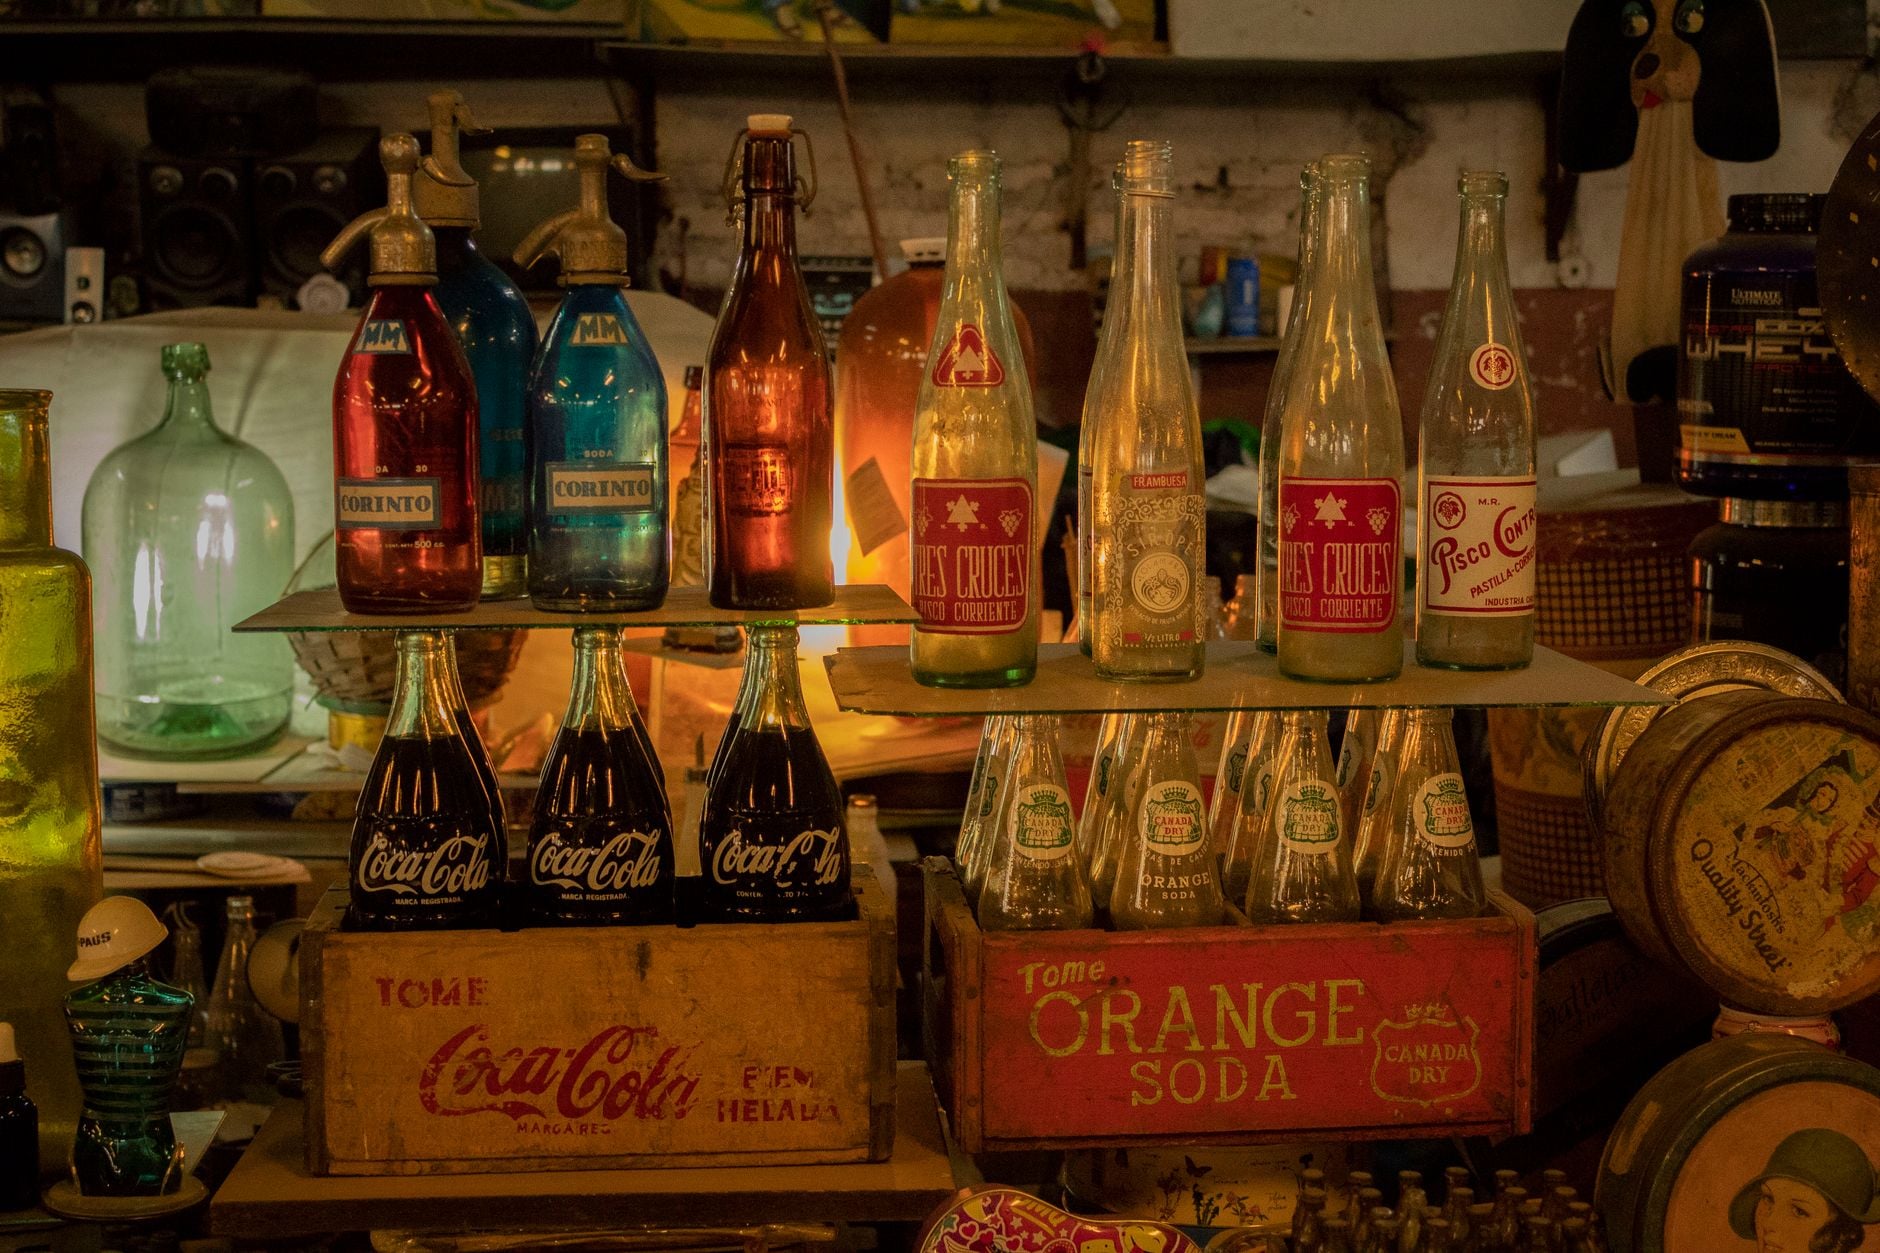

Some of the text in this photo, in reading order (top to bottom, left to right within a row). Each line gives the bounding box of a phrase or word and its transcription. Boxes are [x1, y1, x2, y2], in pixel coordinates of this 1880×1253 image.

[1731, 289, 1781, 299] ULTIMATE
[580, 314, 621, 342] MM
[583, 449, 614, 458] SODA
[415, 464, 428, 473] 30
[555, 479, 650, 497] CORINTO
[1133, 475, 1187, 488] FRAMBUESA
[342, 494, 431, 513] CORINTO
[1478, 498, 1500, 506] M.R.
[1493, 502, 1536, 558] CONTR
[414, 540, 432, 549] 500
[1126, 531, 1194, 557] SIROPE
[956, 543, 1025, 599] CRUCES
[1323, 541, 1392, 595] CRUCES
[954, 600, 1017, 621] CORRIENTE
[1285, 596, 1383, 619] PISCO CORRIENTE
[1157, 633, 1180, 642] LITRO
[1024, 818, 1063, 827] CANADA
[1154, 816, 1193, 826] CANADA
[1293, 813, 1330, 822] CANADA
[1446, 816, 1464, 825] DRY
[1035, 829, 1054, 837] DRY
[1164, 827, 1184, 835] DRY
[1302, 824, 1321, 832] DRY
[359, 831, 489, 895] Coca-Cola
[531, 828, 661, 891] Coca-Cola
[1170, 857, 1182, 866] DE
[1141, 872, 1210, 889] ORANGE
[394, 898, 419, 906] MARCA
[561, 893, 628, 901] MARCA REGISTRADA
[1161, 890, 1196, 900] SODA
[1691, 838, 1787, 973] Quality Street
[1017, 957, 1106, 994] Tome
[375, 976, 489, 1009] TOME
[1029, 978, 1366, 1058] ORANGE
[1384, 1043, 1471, 1063] CANADA
[418, 1022, 703, 1121] Coca-Cola
[1408, 1065, 1449, 1085] DRY
[1130, 1054, 1297, 1107] SODA
